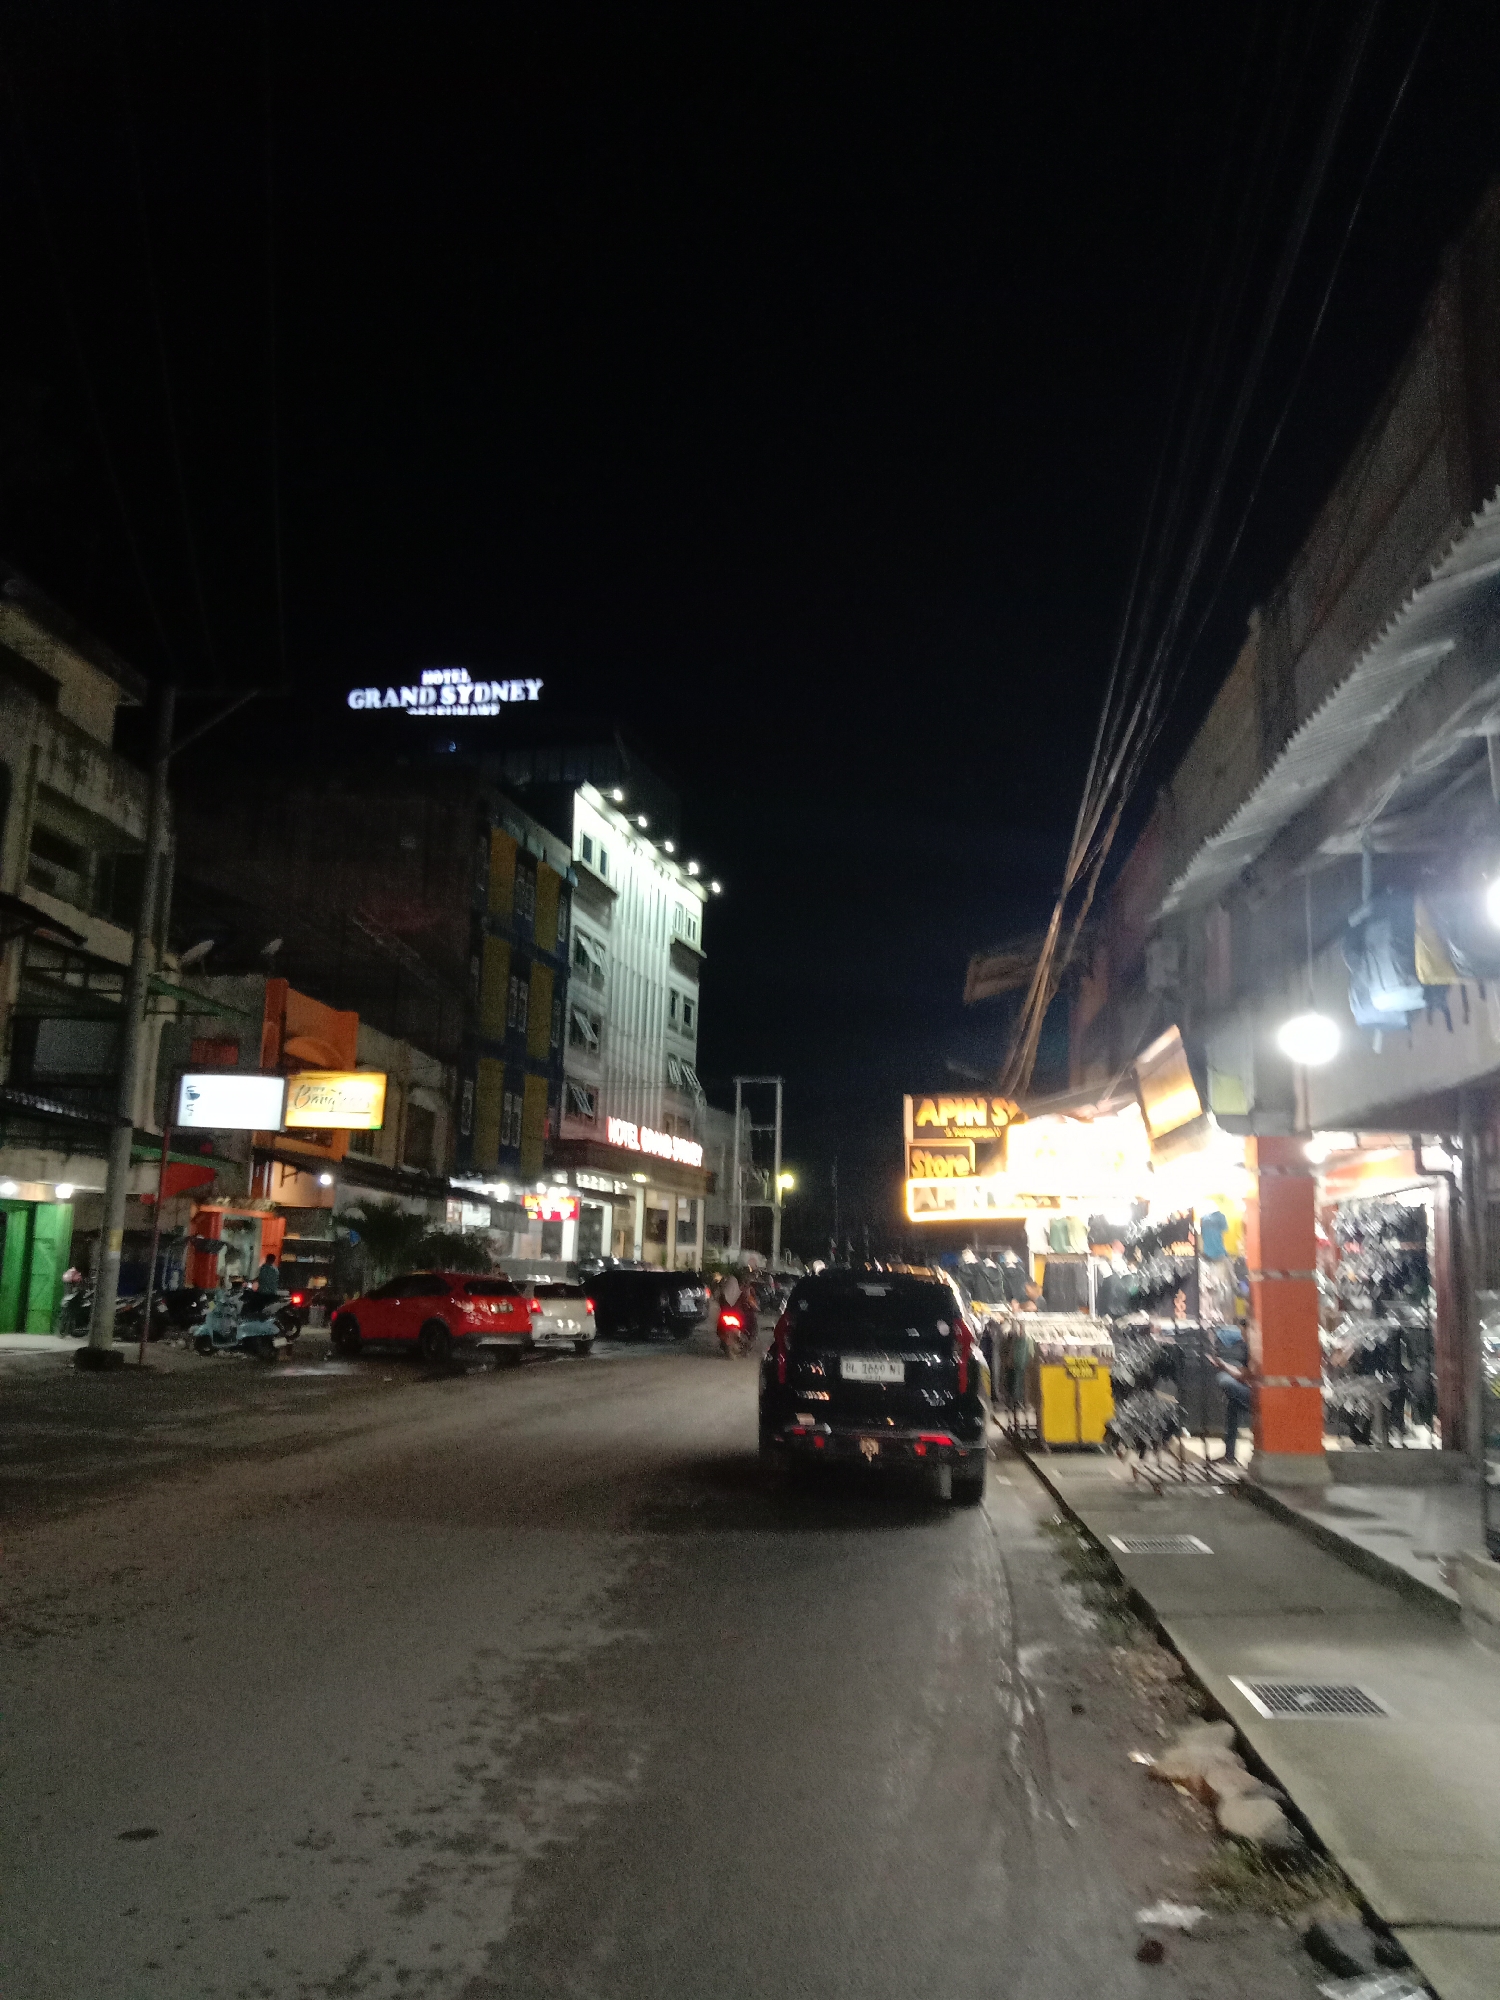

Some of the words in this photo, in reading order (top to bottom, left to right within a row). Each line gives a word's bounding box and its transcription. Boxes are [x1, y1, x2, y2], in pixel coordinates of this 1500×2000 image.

[422, 668, 470, 685] HOTEL
[348, 686, 437, 709] GRAND
[439, 678, 543, 705] SYDNEY
[915, 1097, 988, 1127] APIN
[911, 1148, 971, 1178] Store
